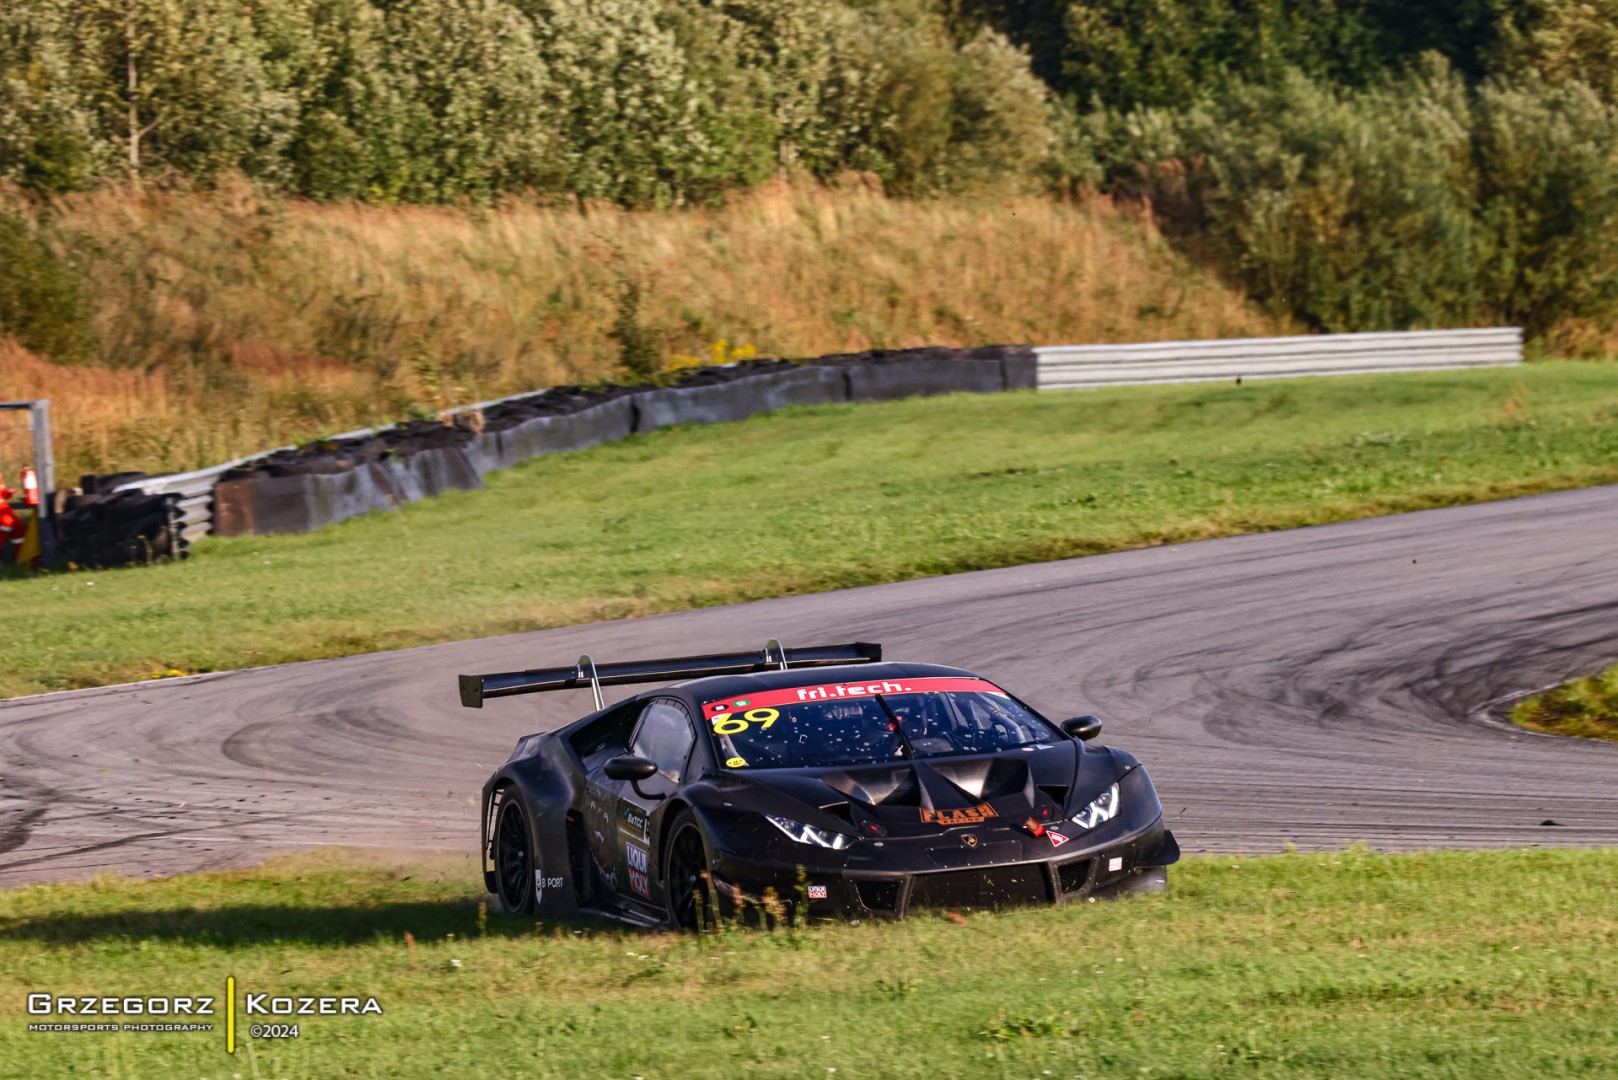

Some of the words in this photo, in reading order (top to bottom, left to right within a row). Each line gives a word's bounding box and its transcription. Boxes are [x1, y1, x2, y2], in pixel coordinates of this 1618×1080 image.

[797, 682, 911, 700] fri.tech.
[713, 708, 779, 734] 69
[922, 803, 997, 821] FLASH
[627, 844, 647, 873] LIQUI
[547, 877, 563, 888] PORT
[628, 870, 649, 896] MOLY
